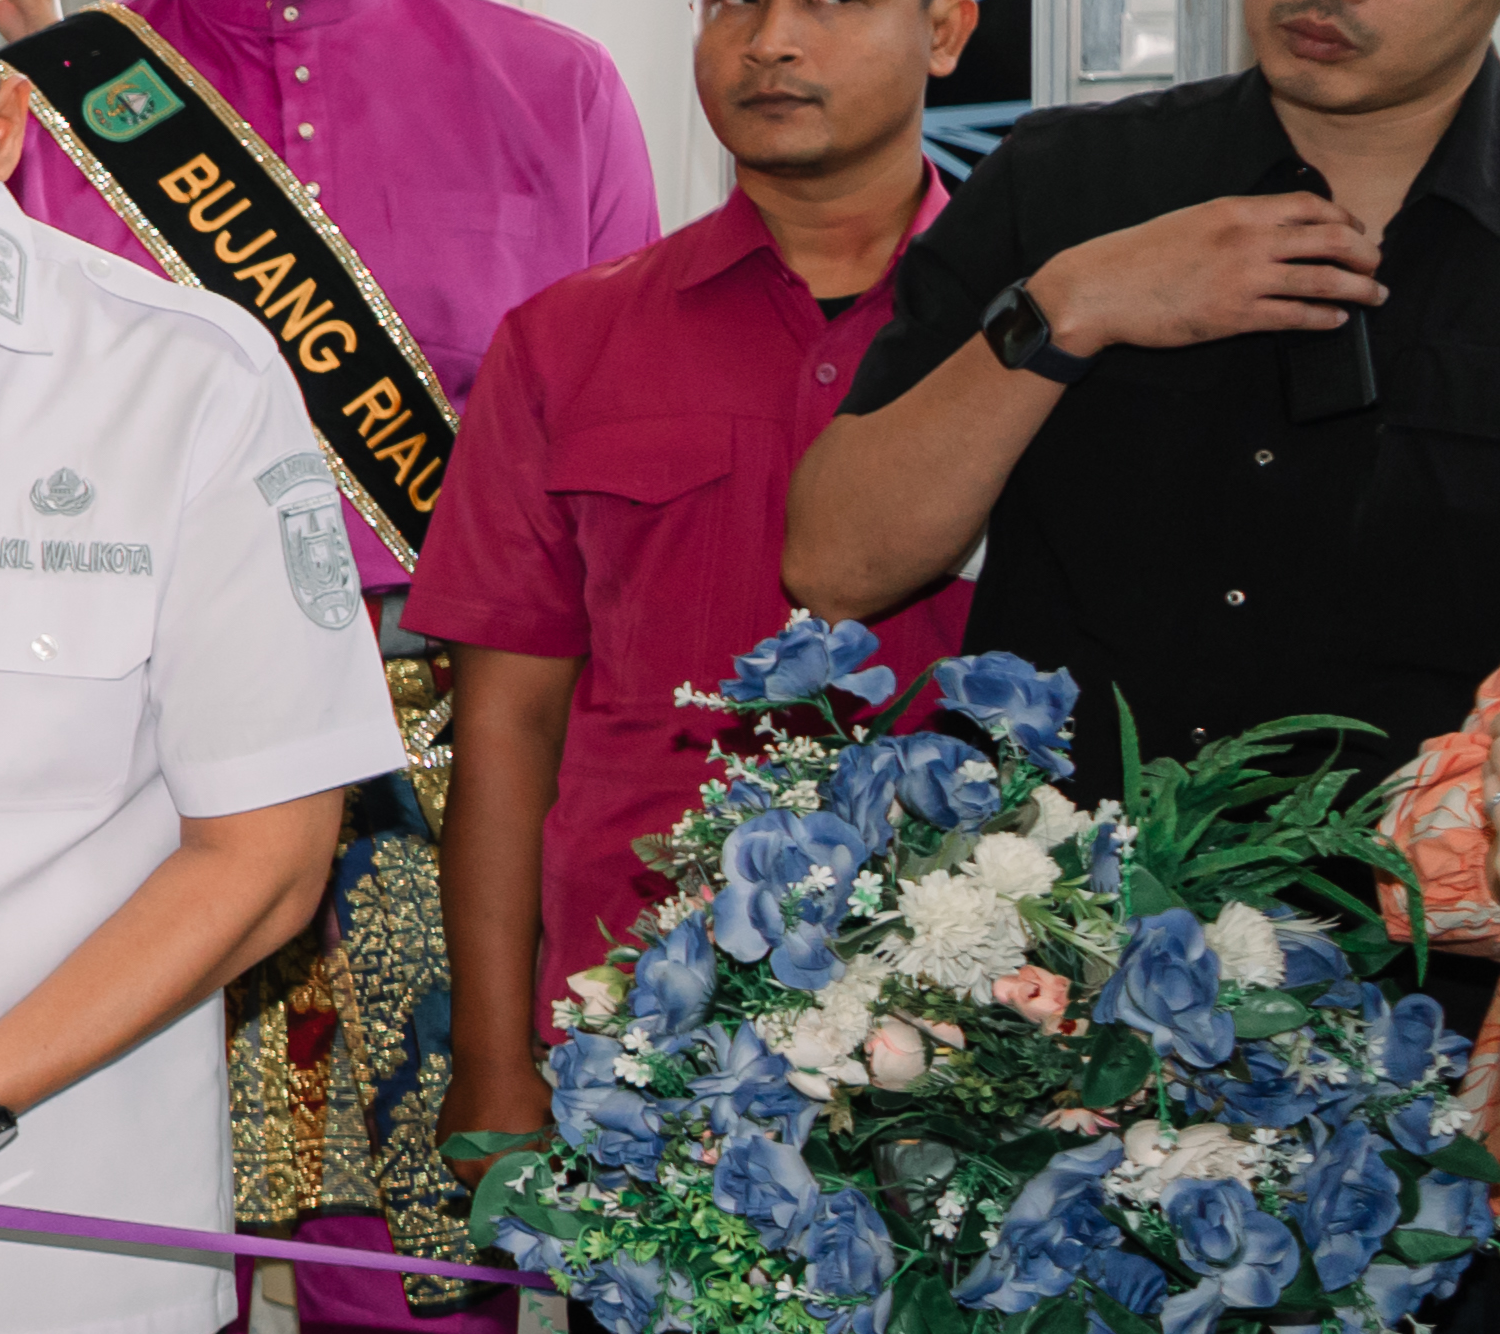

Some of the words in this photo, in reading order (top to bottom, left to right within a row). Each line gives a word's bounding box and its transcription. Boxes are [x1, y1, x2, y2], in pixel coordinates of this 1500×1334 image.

[158, 152, 358, 374] BUJANG
[342, 376, 442, 513] RIAU
[41, 540, 154, 577] WALIKOTA
